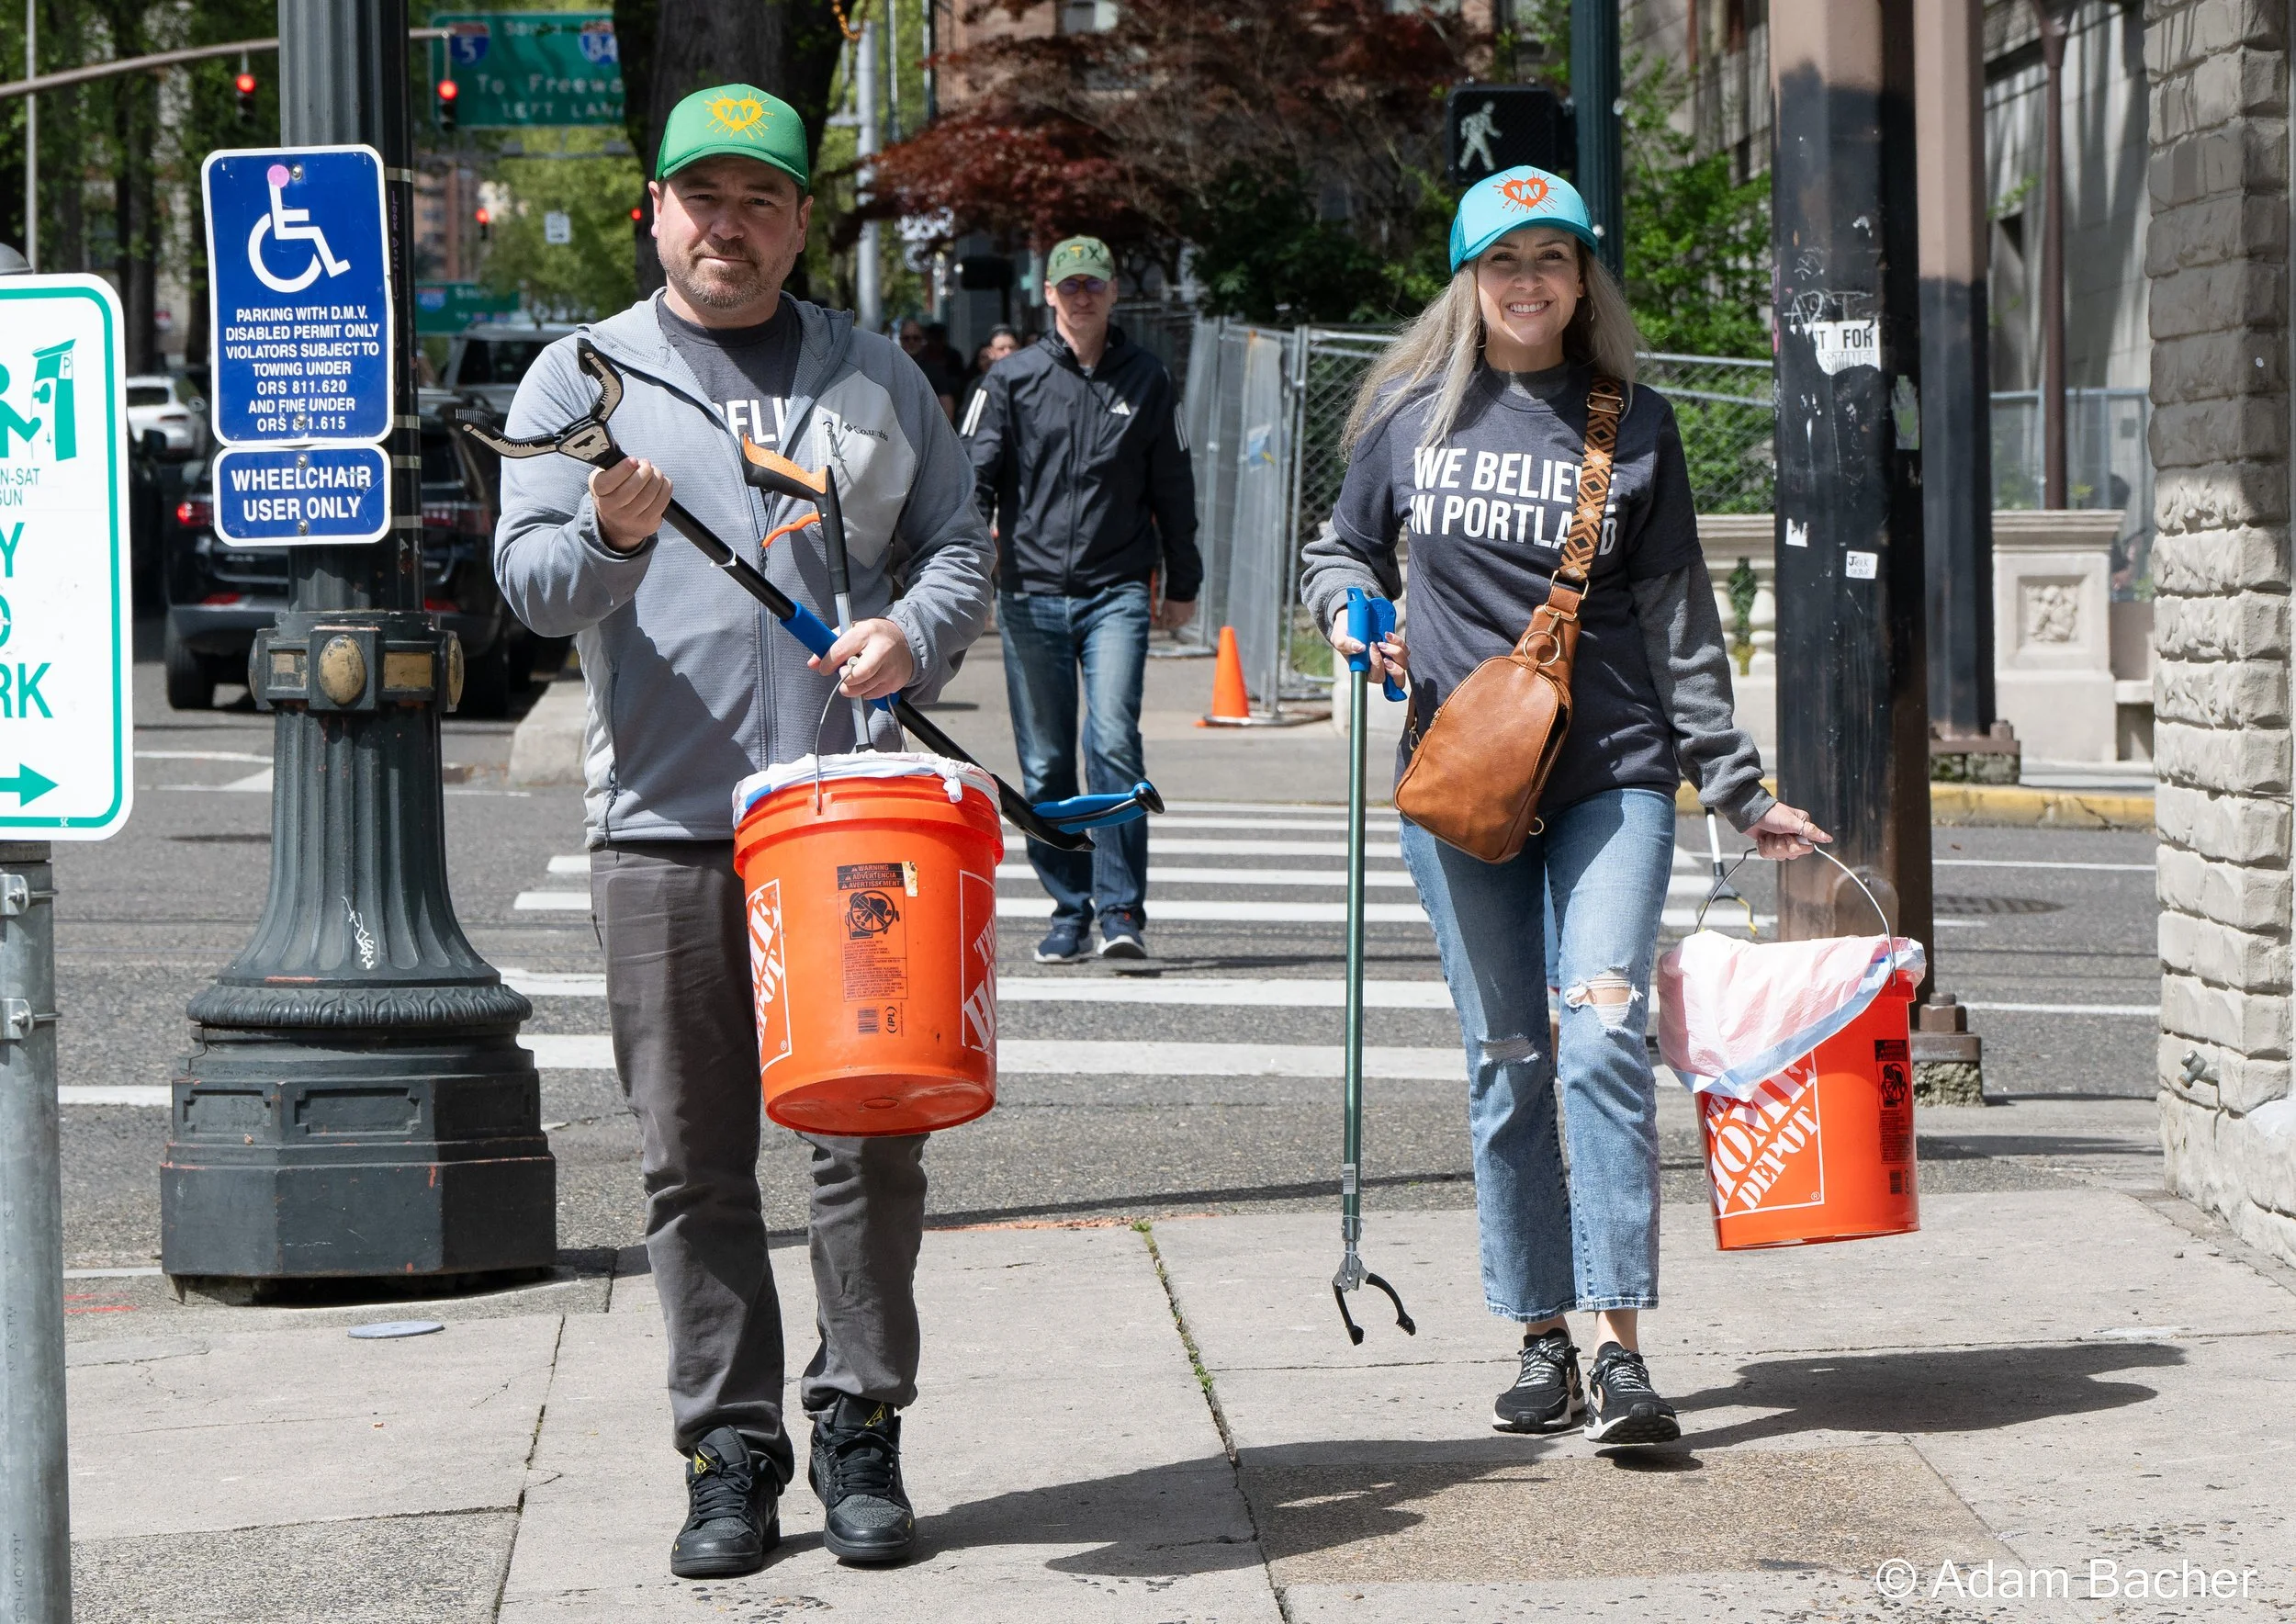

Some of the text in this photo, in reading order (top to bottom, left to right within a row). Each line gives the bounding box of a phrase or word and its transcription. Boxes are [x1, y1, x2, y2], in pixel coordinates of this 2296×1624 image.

[460, 37, 478, 63] 5
[477, 73, 505, 95] To
[236, 305, 368, 322] PARKING WITH D.M.V.
[225, 323, 379, 342] DISABLED PERMIT ONLY
[1842, 328, 1873, 348] FOR
[225, 342, 379, 359] VIOLATORS SUBJECT TO
[253, 361, 352, 378] TOWING UNDER
[256, 379, 347, 395] ORS 811.620
[248, 398, 355, 414] AND FINE UNDER
[256, 416, 346, 432] ORS 1.615
[854, 425, 888, 442] Coumbia
[1414, 446, 1468, 491] WE
[231, 466, 371, 491] WHEELCHAIR
[243, 496, 361, 522] USER ONLY
[1410, 494, 1618, 557] IN PORTLAD
[849, 881, 900, 889] AVERTISSEMENT
[852, 872, 896, 880] ADVERTENCIA
[1737, 1105, 1818, 1210] DEPOT
